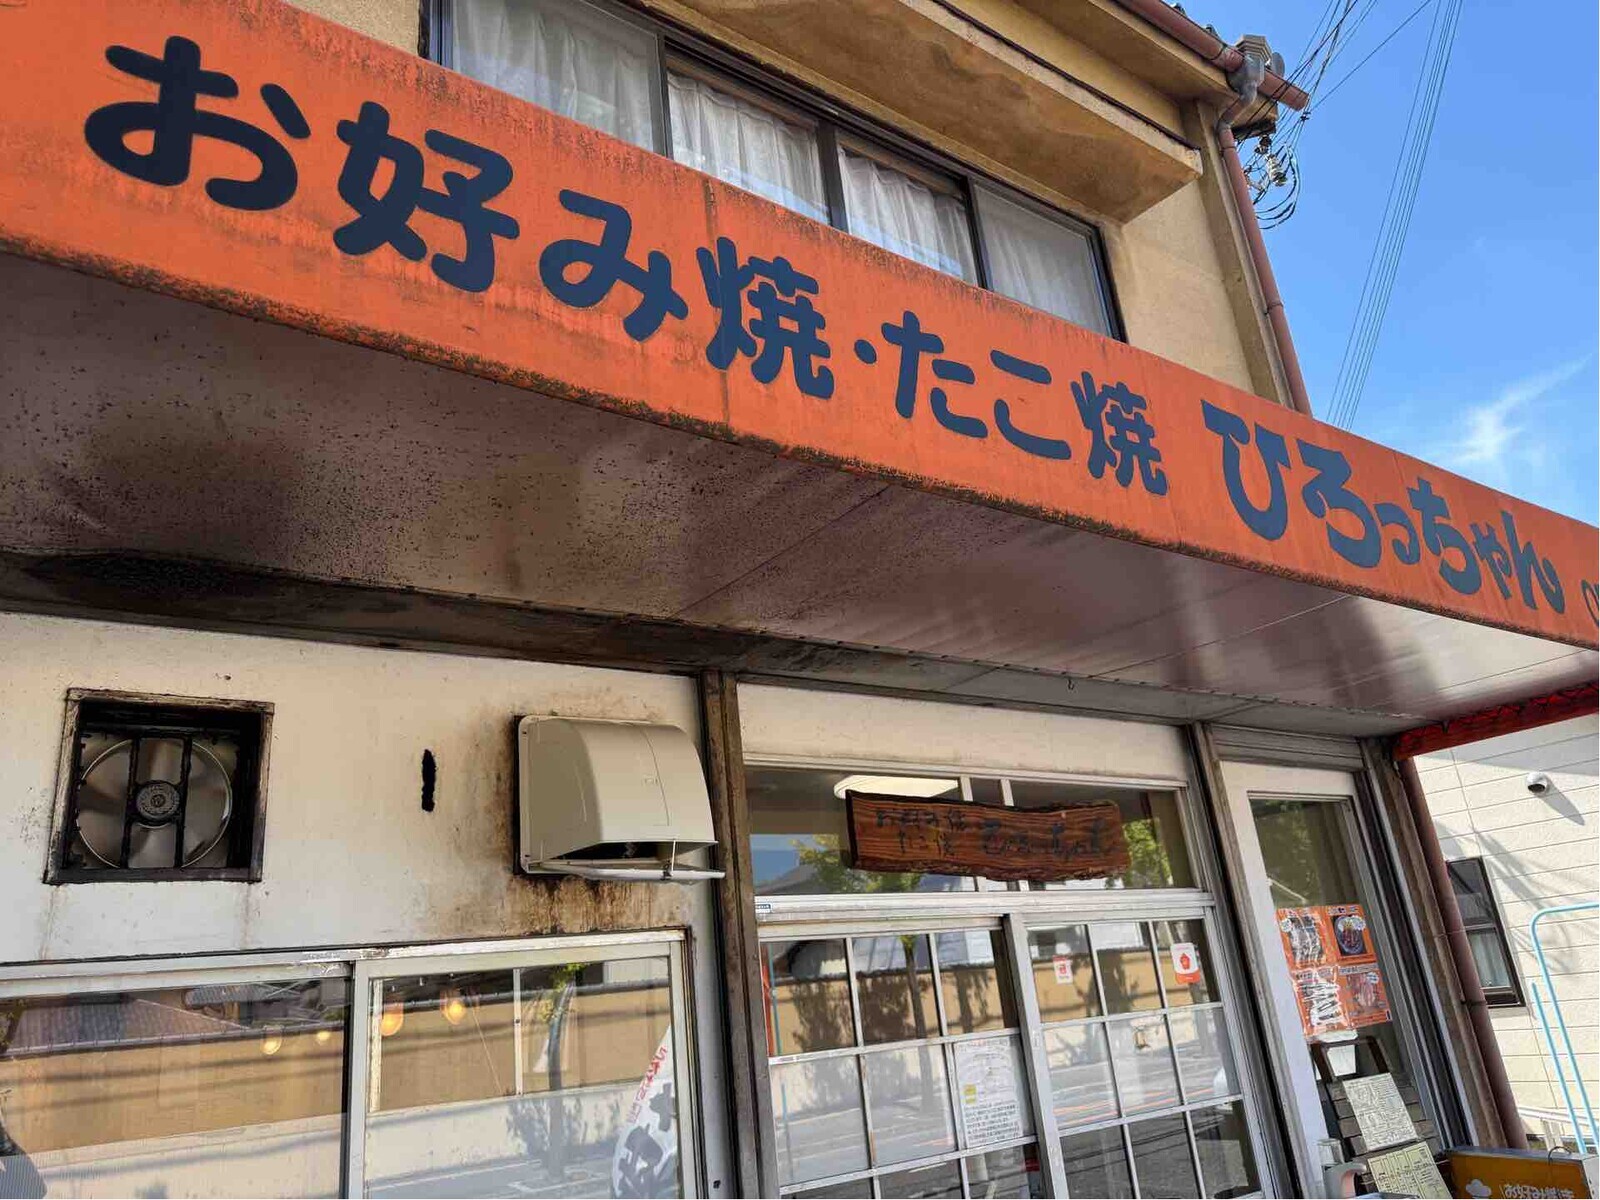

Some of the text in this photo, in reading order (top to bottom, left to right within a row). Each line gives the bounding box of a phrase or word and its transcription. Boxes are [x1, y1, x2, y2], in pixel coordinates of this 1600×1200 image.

[85, 36, 1565, 613] お好み焼・たこ焼 ひろっちゃん
